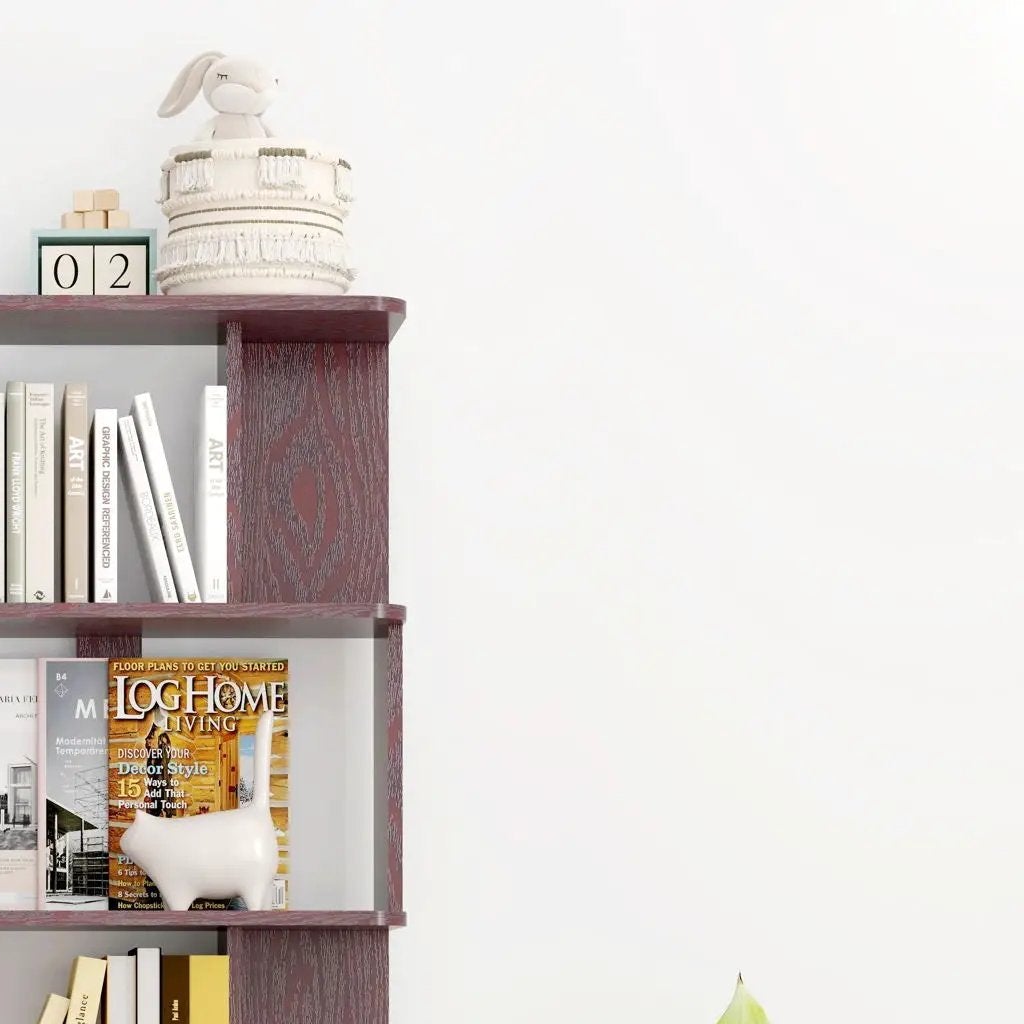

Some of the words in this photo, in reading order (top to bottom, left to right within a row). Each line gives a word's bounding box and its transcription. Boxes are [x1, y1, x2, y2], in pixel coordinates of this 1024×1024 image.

[69, 436, 85, 471] ART
[101, 426, 111, 468] GRAPHIC
[209, 438, 223, 472] ART
[101, 470, 111, 505] DESIGN
[101, 507, 111, 569] REFERENCED
[113, 662, 144, 671] FLOOR
[147, 662, 179, 671] PLANS
[182, 662, 195, 671] TO
[198, 662, 216, 671] GET
[219, 662, 238, 671] YOU
[242, 662, 285, 671] STARTED
[164, 716, 237, 732] LIVING
[118, 748, 163, 759] DISCOVER
[166, 748, 190, 759] YOUR
[118, 762, 164, 775] Decor
[167, 762, 208, 779] Style
[117, 778, 142, 798] 15
[144, 777, 167, 788] Ways
[170, 778, 180, 787] to
[144, 788, 162, 798] Add
[164, 788, 185, 798] That
[118, 800, 157, 809] Personal
[160, 800, 187, 809] Touch
[124, 869, 138, 877] Tips
